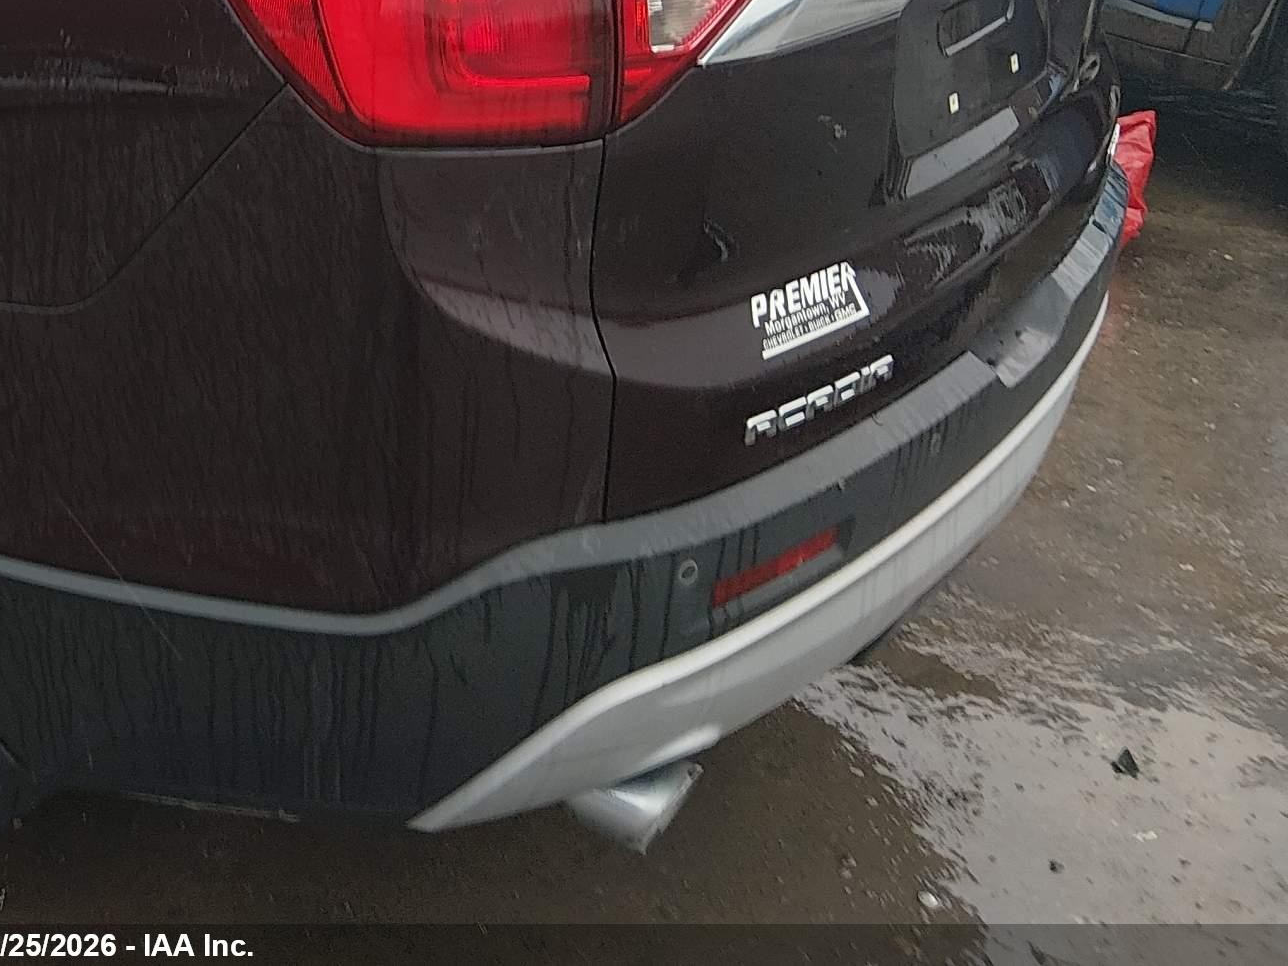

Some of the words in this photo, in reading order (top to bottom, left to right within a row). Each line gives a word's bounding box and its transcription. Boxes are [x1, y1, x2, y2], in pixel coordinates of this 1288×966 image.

[750, 261, 855, 329] PREMIER
[828, 291, 847, 309] WV
[744, 354, 894, 446] ACADIA
